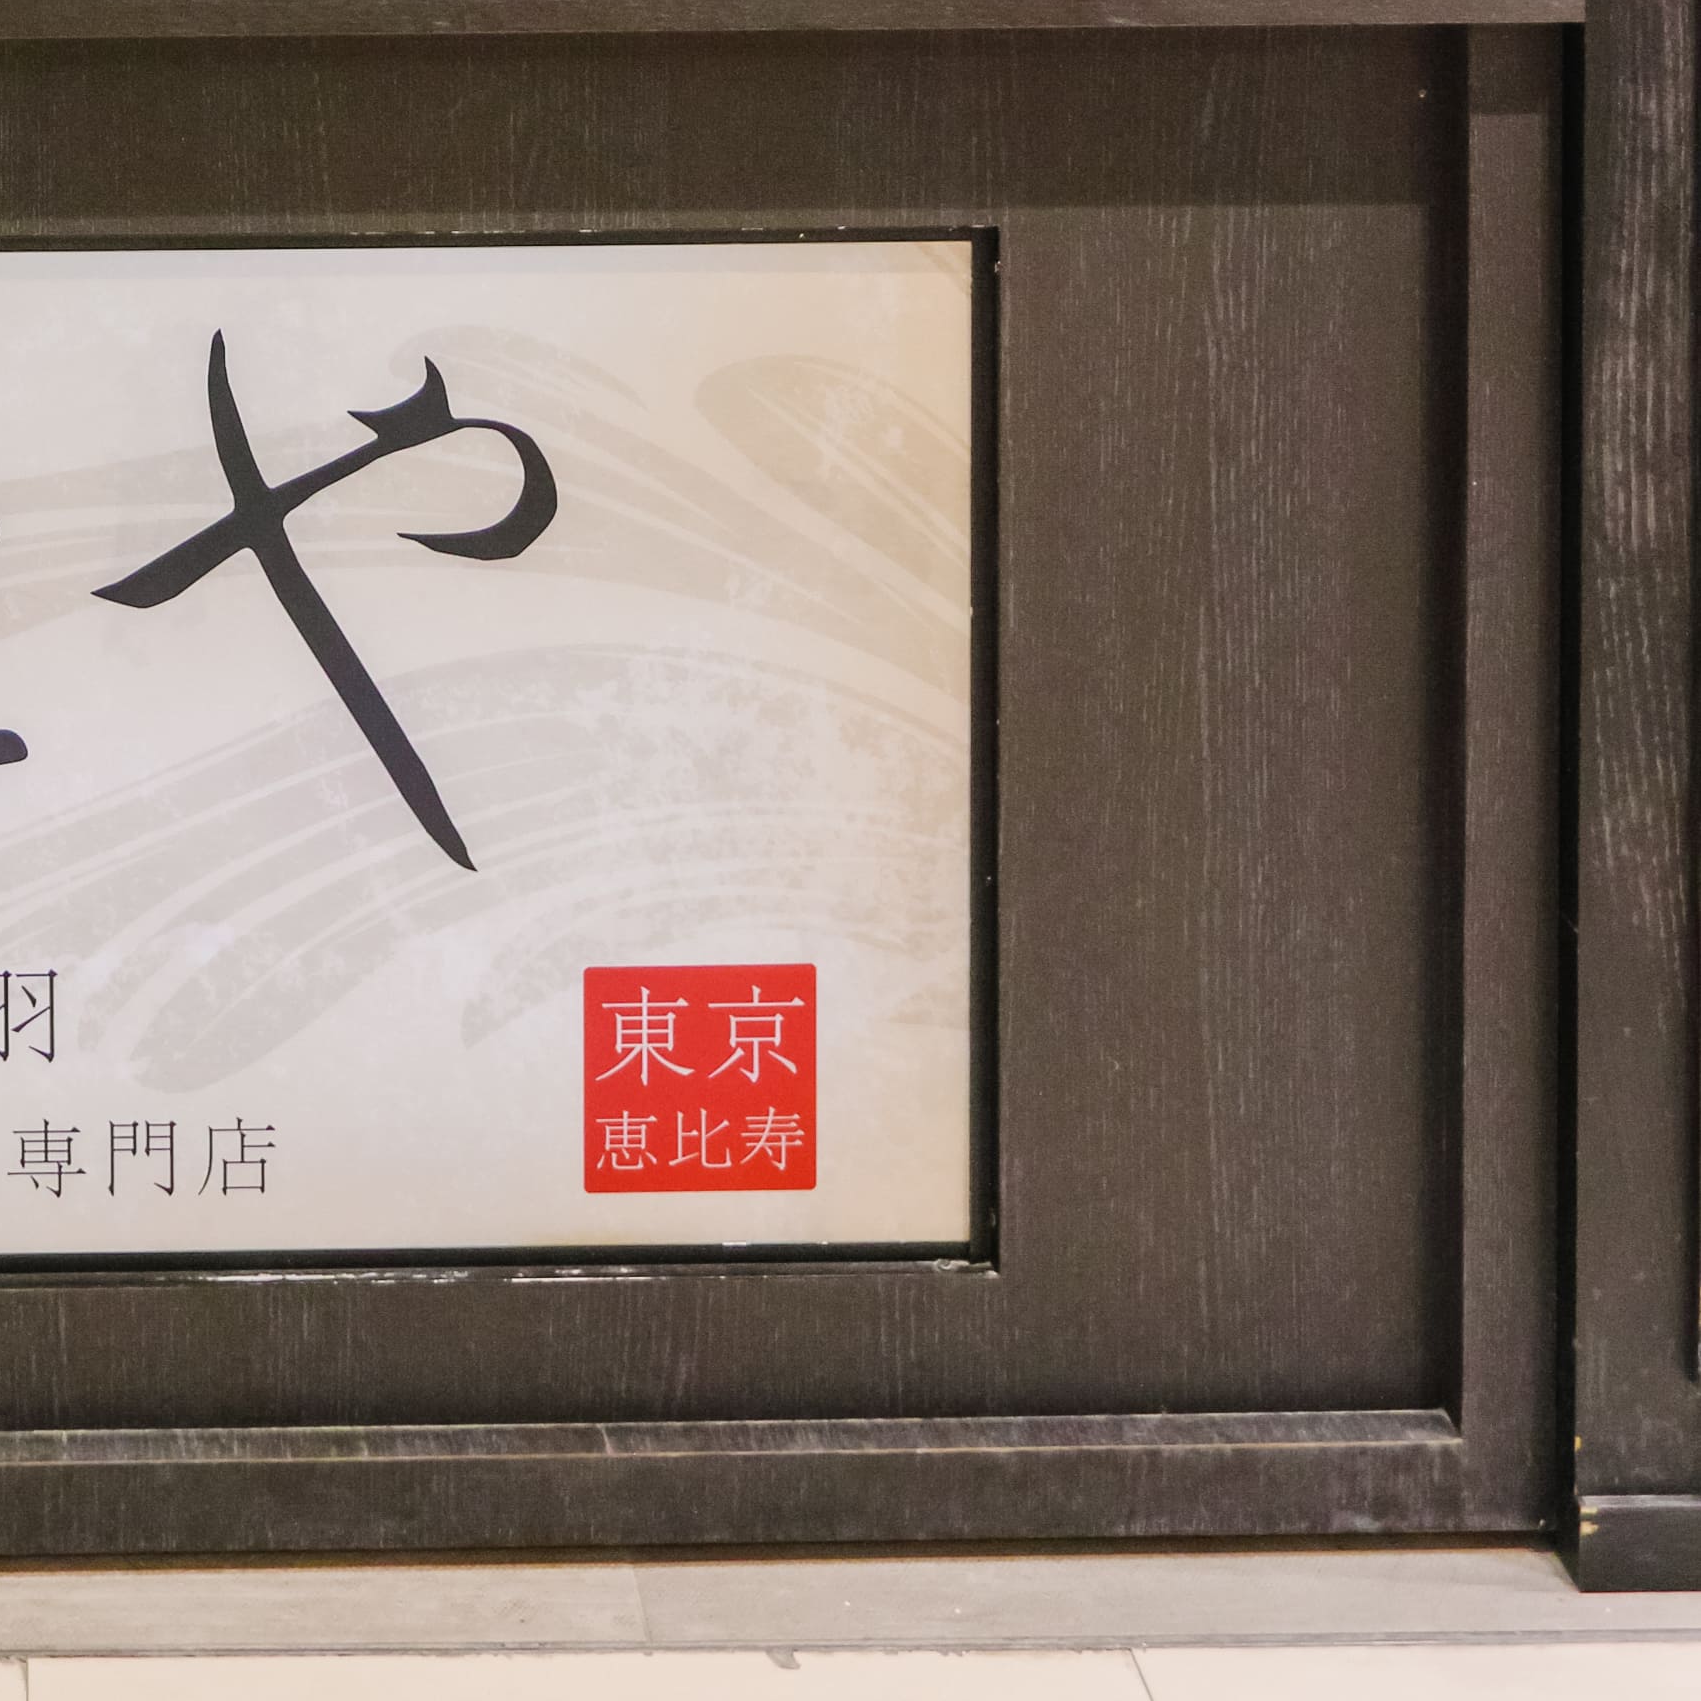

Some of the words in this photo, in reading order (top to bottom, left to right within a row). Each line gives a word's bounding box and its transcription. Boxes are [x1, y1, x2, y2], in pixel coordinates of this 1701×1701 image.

[597, 986, 805, 1085] 東京
[597, 1107, 805, 1170] 恵比寿
